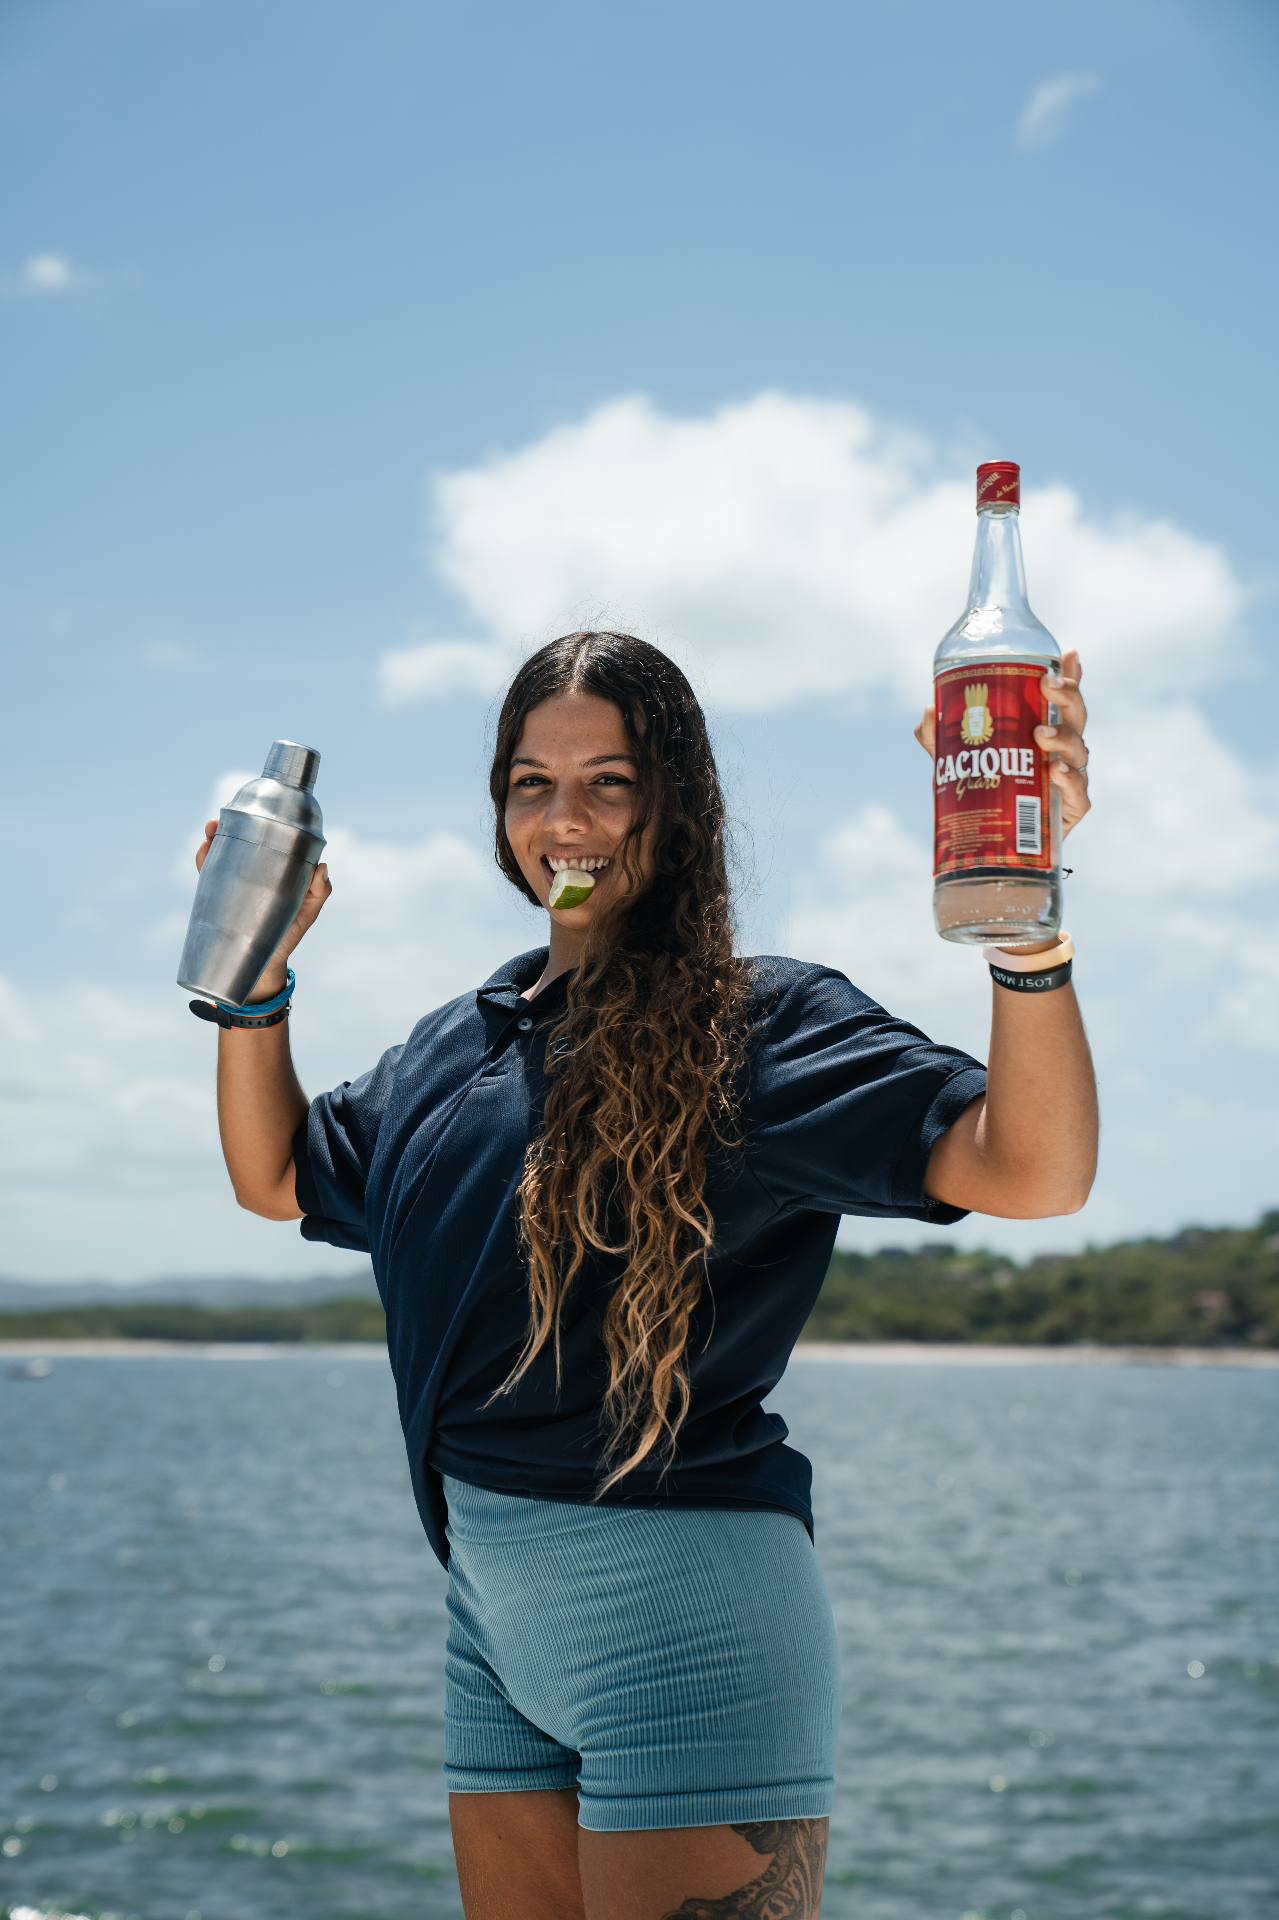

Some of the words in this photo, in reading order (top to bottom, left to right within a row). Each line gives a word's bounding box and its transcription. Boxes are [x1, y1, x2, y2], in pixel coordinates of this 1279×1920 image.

[936, 747, 1034, 786] CACIQUE
[956, 773, 1001, 801] Guaro
[1018, 977, 1052, 987] LOST
